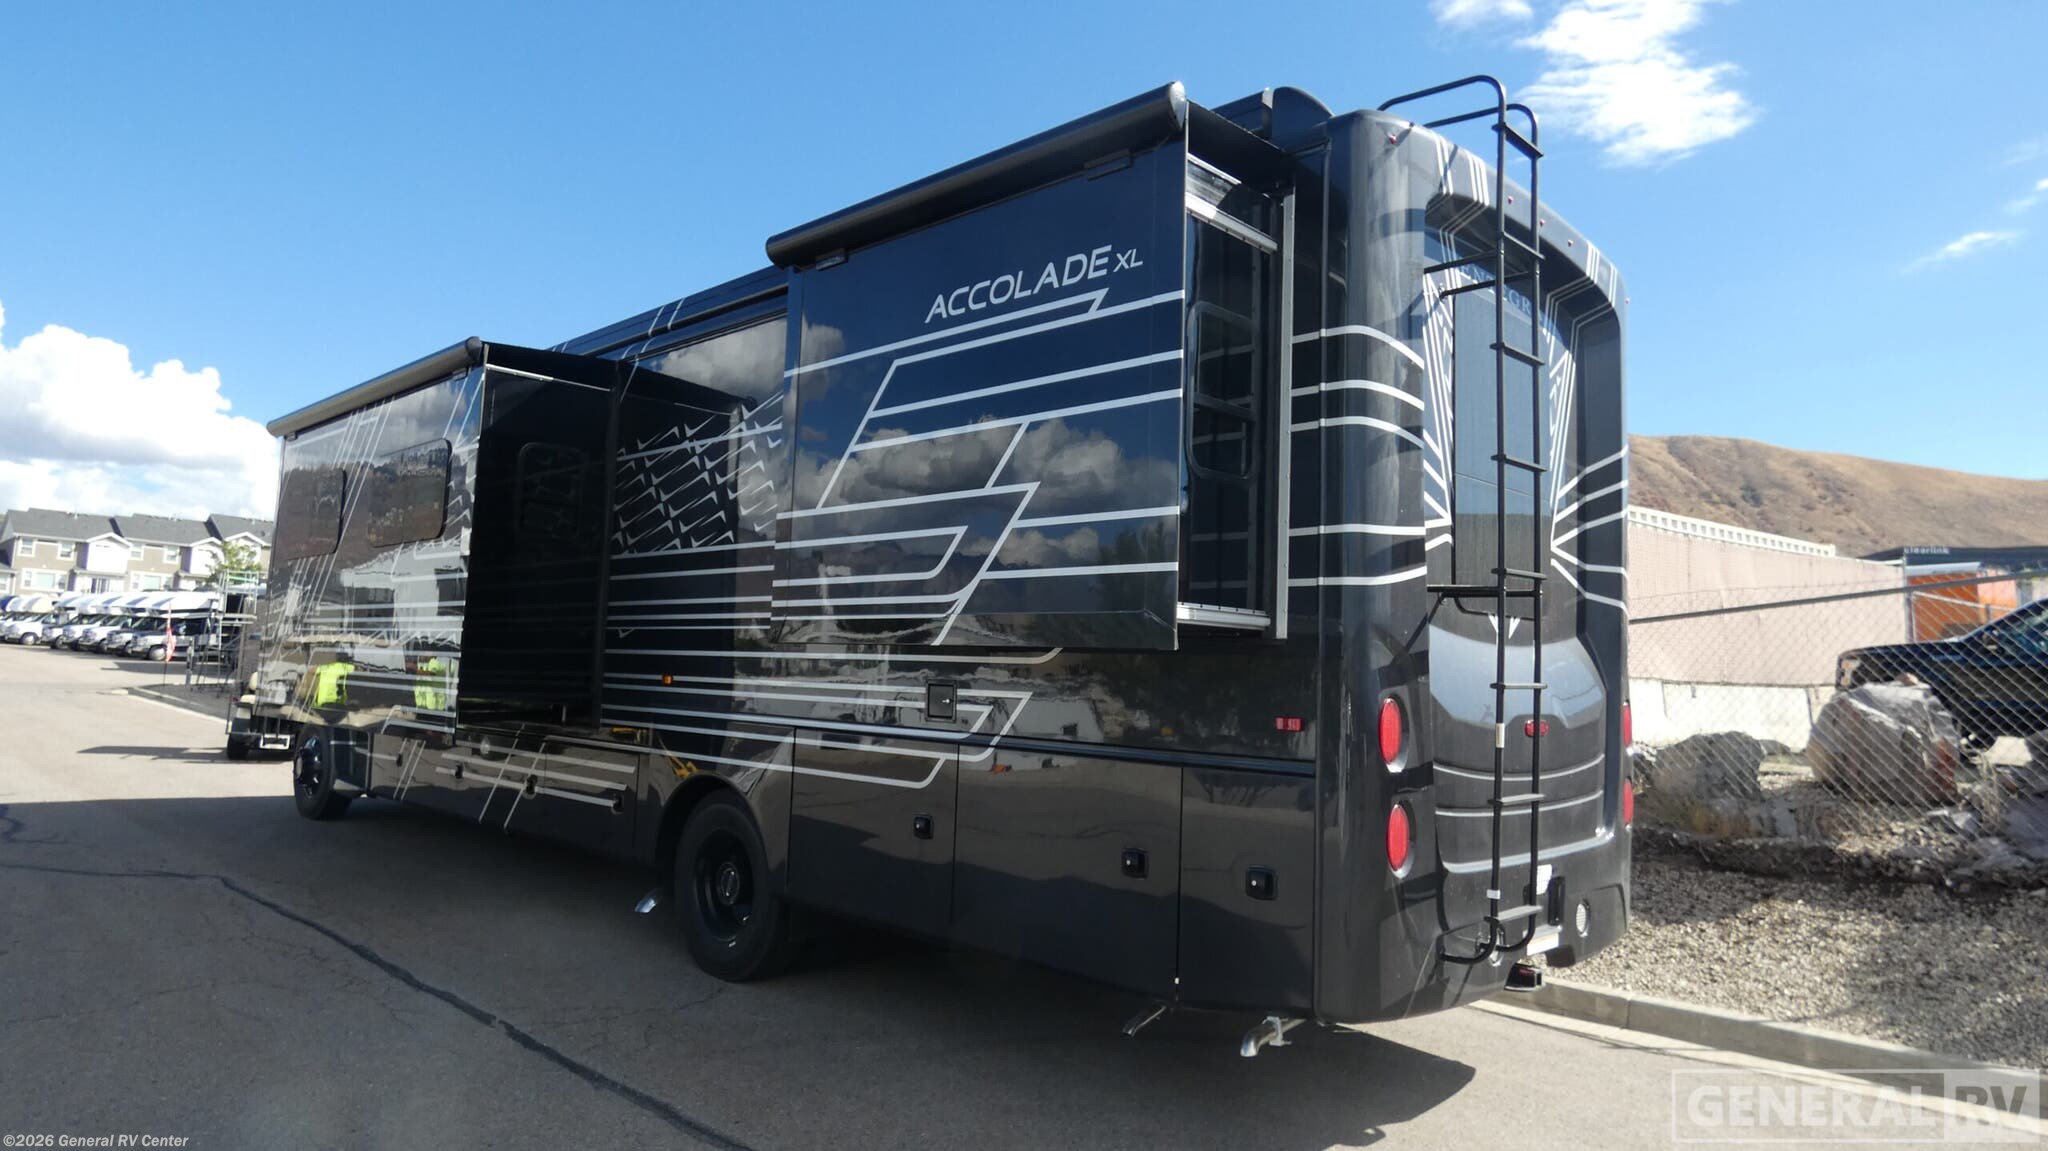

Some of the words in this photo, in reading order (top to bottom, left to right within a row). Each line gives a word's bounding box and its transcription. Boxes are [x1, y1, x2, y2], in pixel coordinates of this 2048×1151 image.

[924, 244, 1112, 323] ACCOLADE
[1113, 248, 1143, 272] XL
[1460, 264, 1542, 321] ENGR
